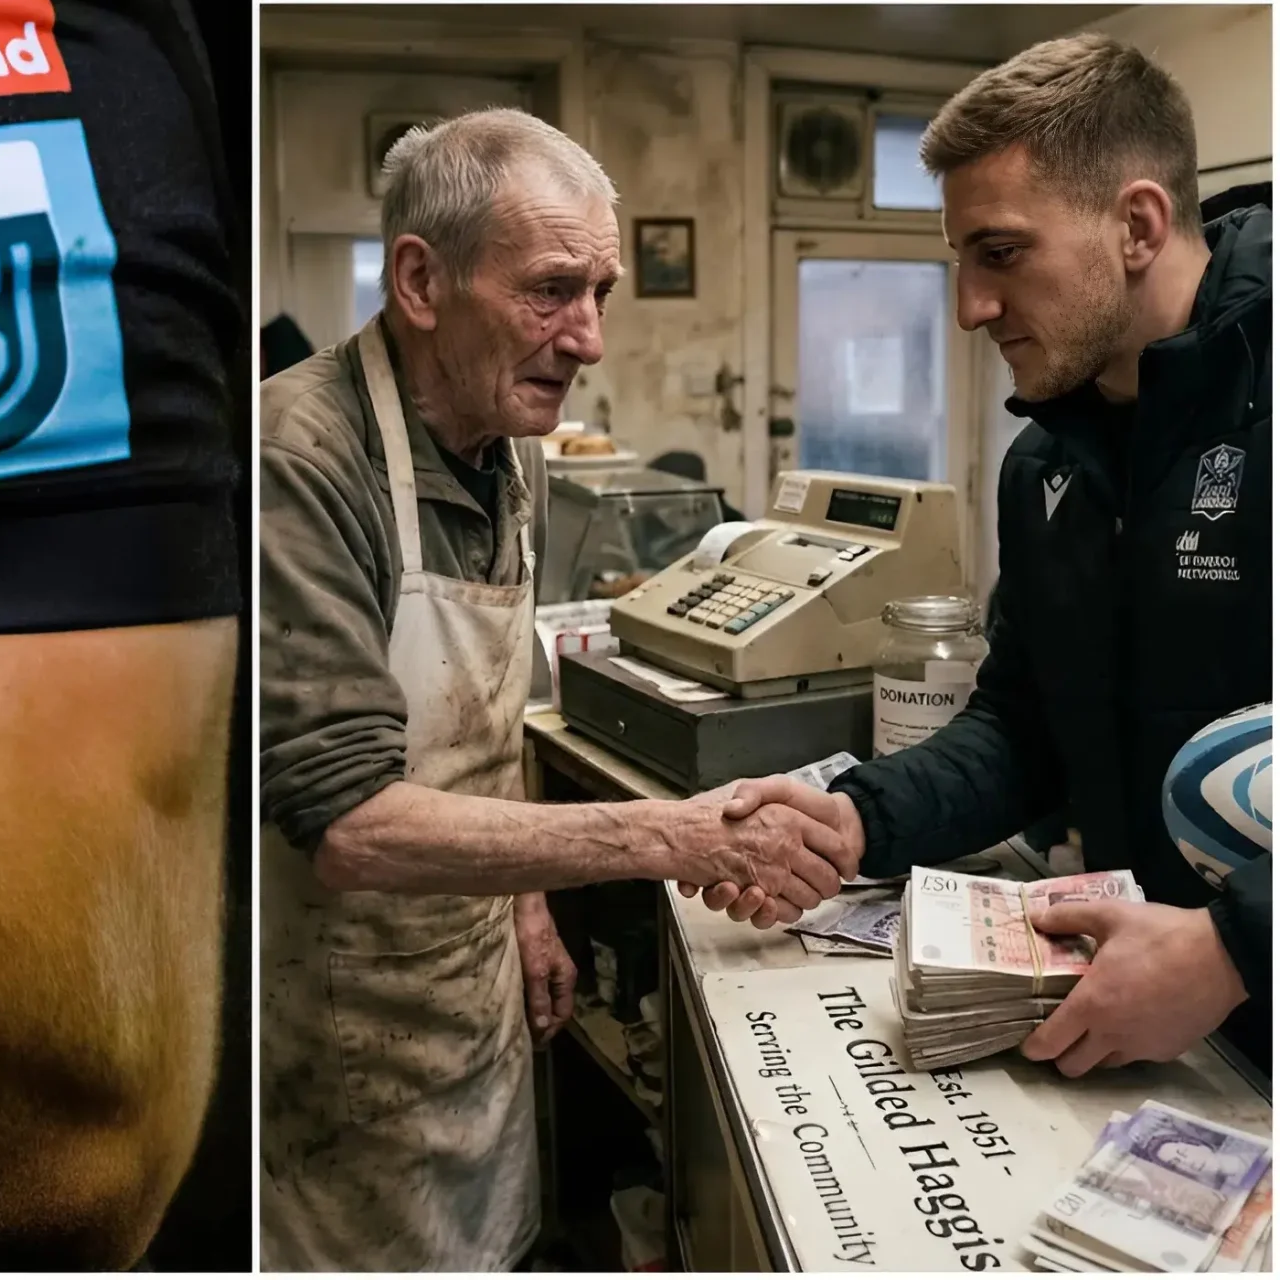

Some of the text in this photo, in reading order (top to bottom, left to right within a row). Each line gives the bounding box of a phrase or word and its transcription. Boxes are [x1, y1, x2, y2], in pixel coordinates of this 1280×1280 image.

[880, 687, 955, 706] DONATION
[774, 1085, 811, 1116] the
[793, 1123, 877, 1266] Community
[817, 986, 1004, 1272] The Gilded Haggis
[957, 1111, 1016, 1159] 1951
